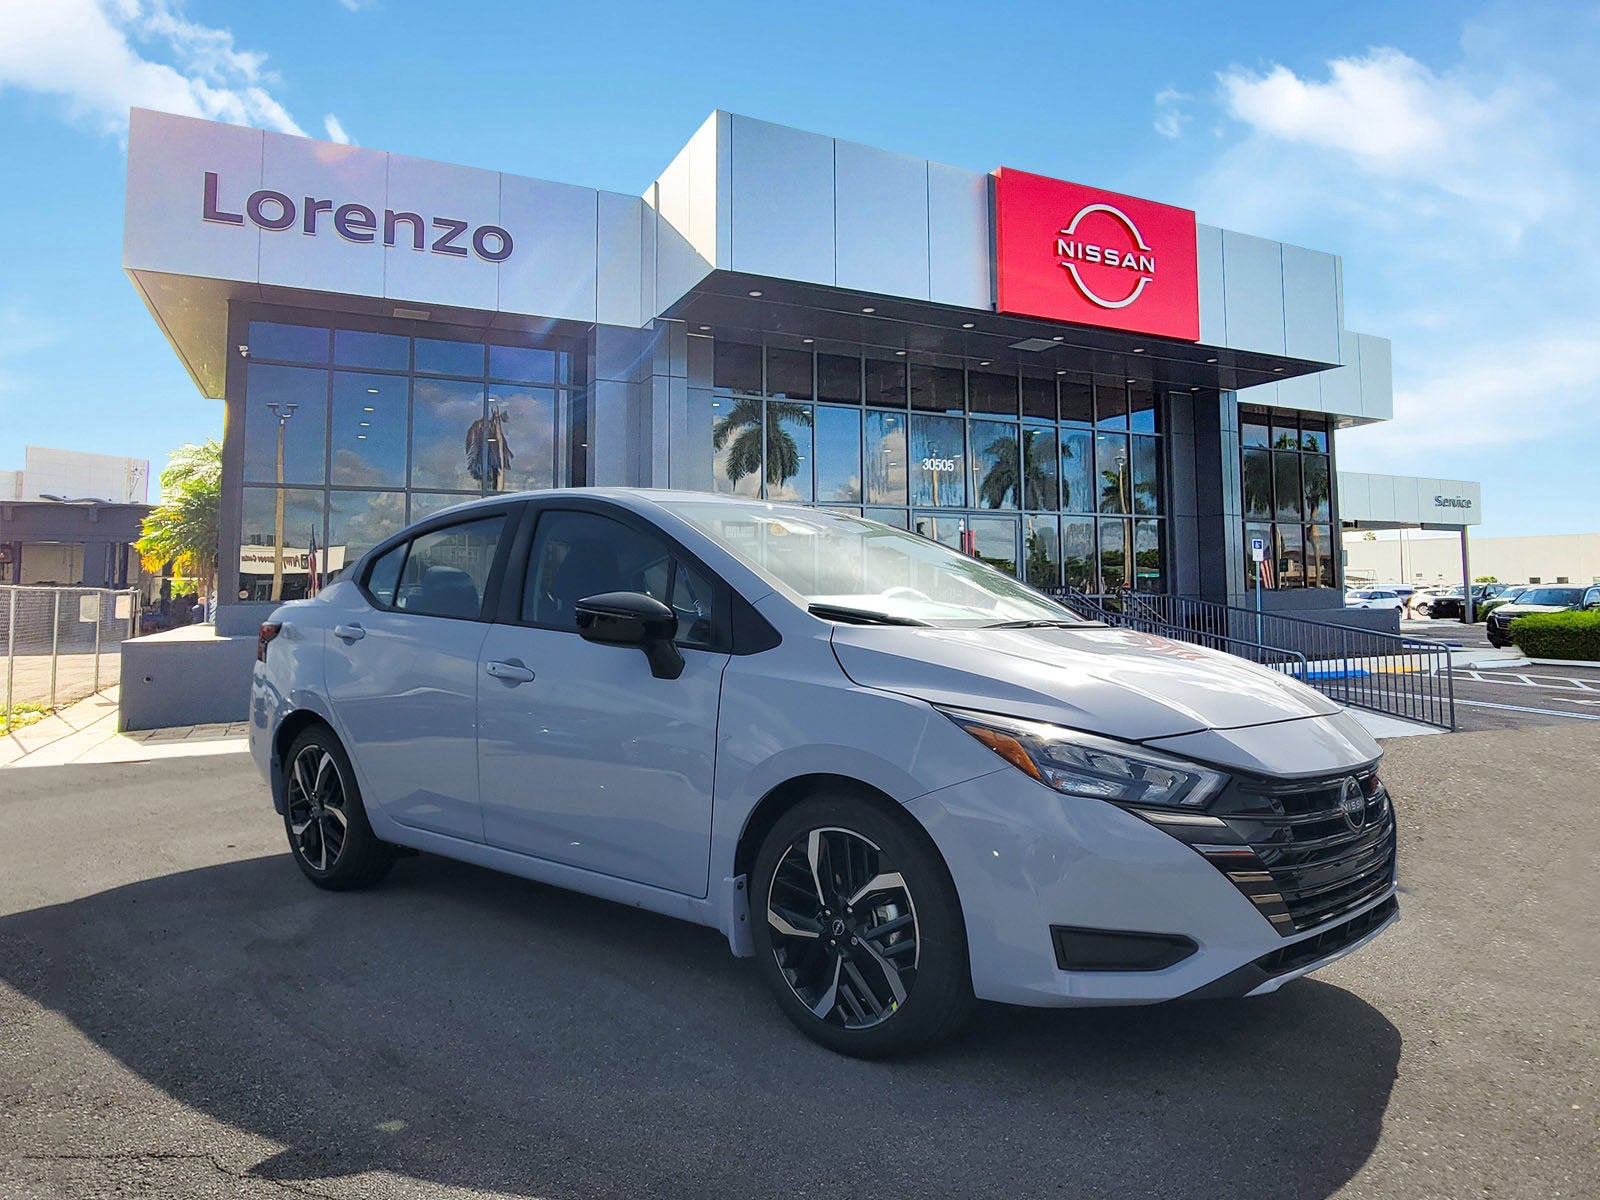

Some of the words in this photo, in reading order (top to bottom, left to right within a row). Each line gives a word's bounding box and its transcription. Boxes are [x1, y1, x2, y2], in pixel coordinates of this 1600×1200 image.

[202, 171, 514, 262] Lorenzo
[1057, 238, 1155, 273] NISSAN
[922, 457, 955, 472] 30505
[1434, 495, 1472, 509] Service
[1343, 799, 1361, 812] NISS
